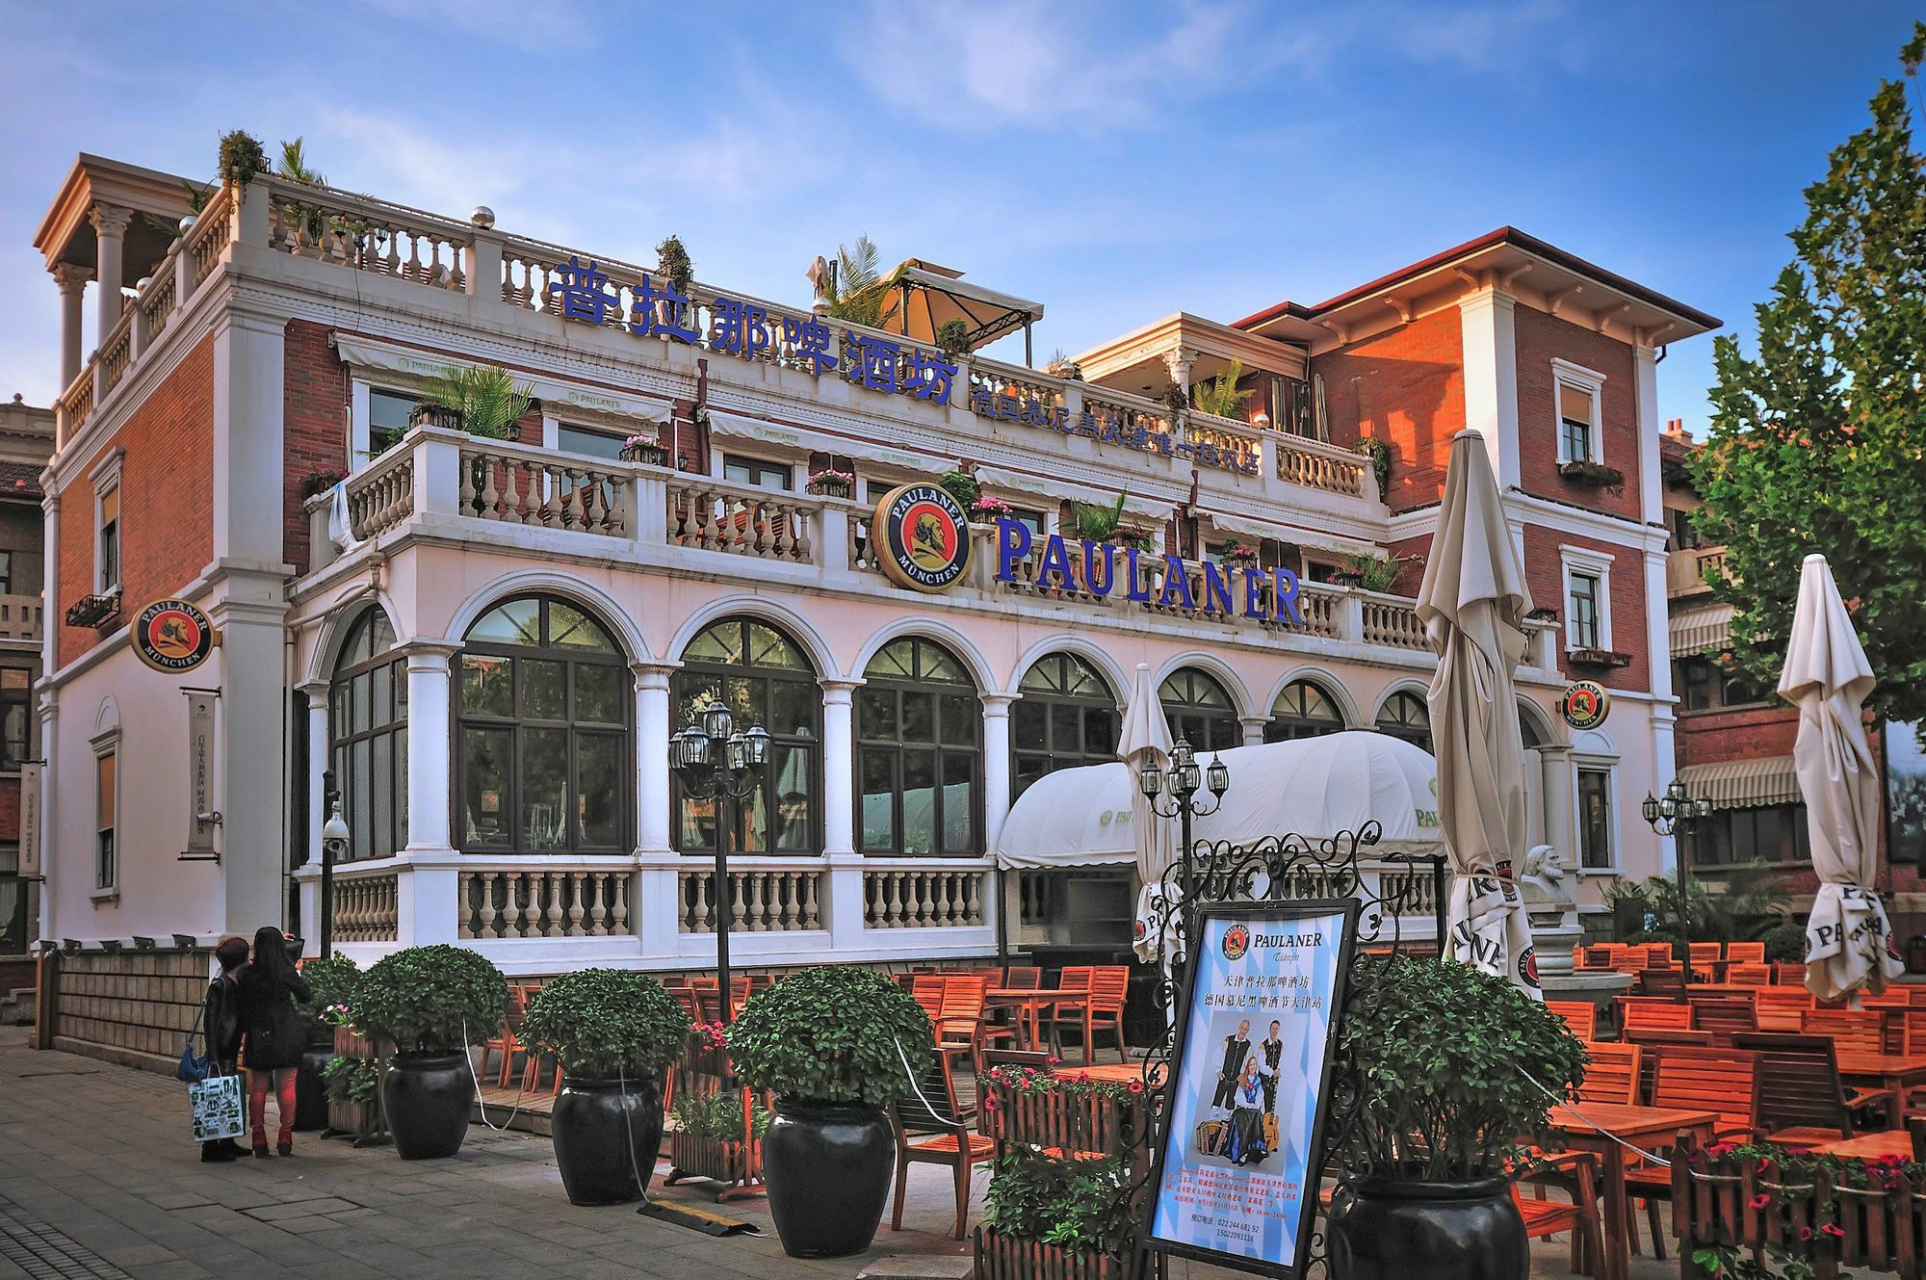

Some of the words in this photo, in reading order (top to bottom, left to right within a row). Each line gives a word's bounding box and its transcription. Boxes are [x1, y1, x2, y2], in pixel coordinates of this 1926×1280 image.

[548, 255, 959, 406] 普拉那啤酒坊
[892, 488, 965, 530] PAULANER
[995, 518, 1304, 627] PAULANER
[141, 601, 208, 631] PAULANER
[1253, 932, 1322, 948] PAULANER
[1223, 975, 1310, 989] 天津普拉那啤酒坊
[1204, 993, 1322, 1009] 德国慕尼黑啤酒节天津站
